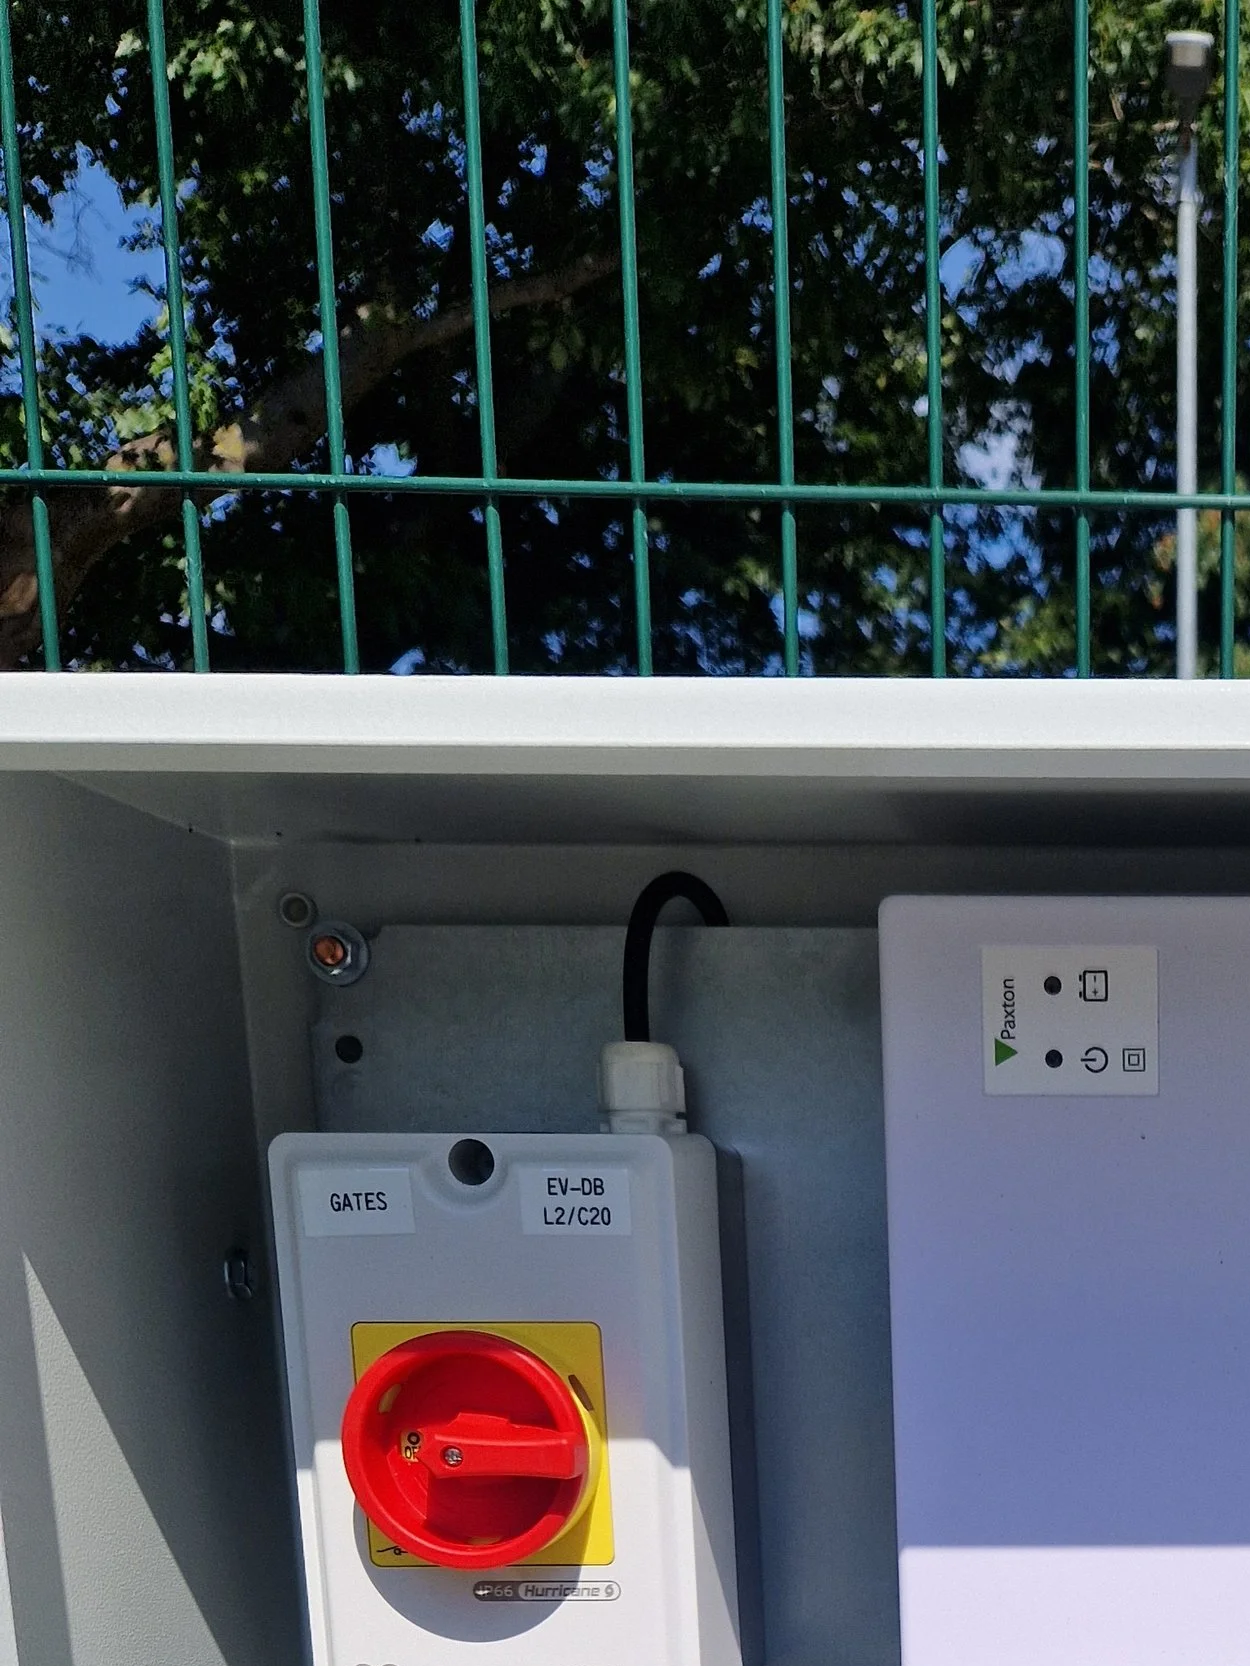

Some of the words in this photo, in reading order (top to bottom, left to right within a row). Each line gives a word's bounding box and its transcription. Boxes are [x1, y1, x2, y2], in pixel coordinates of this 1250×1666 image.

[1001, 978, 1016, 1040] Paxton
[547, 1177, 605, 1197] EV-DB
[329, 1192, 388, 1212] GATES
[543, 1207, 612, 1226] L2/C20
[524, 1583, 600, 1598] Hurricane
